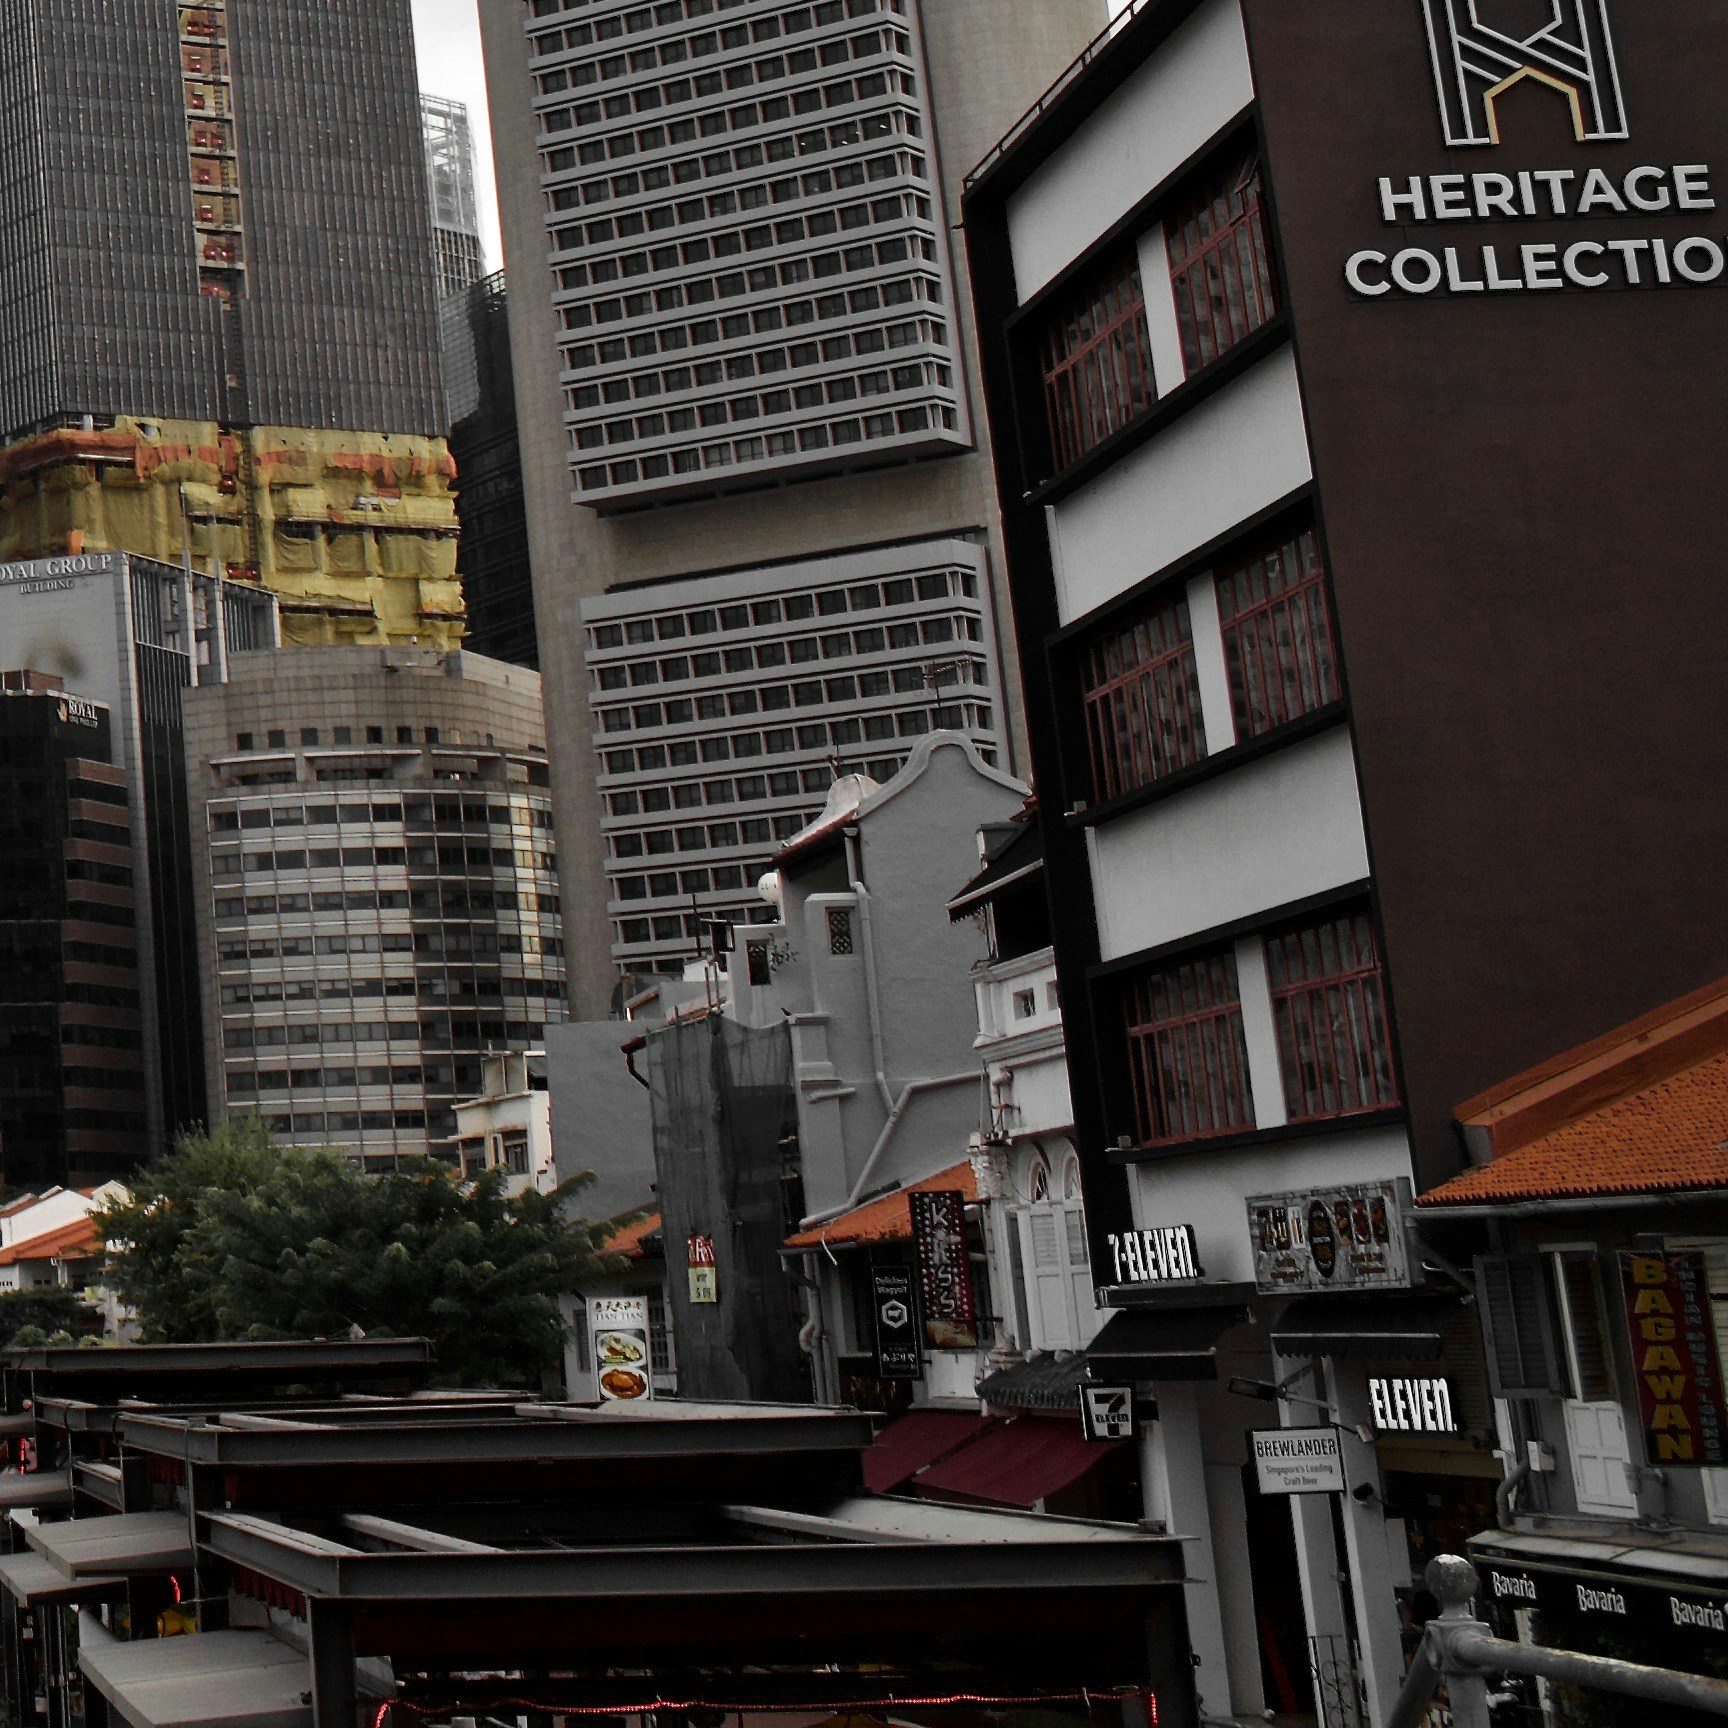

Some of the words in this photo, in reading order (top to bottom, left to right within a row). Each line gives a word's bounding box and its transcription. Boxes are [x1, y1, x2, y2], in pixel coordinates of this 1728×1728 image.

[1378, 164, 1715, 222] HERITAGE
[1345, 236, 1728, 296] COLLECTIO
[46, 553, 112, 576] GROUP
[21, 580, 75, 595] BUILDING
[68, 700, 98, 721] ROYAL
[1630, 1256, 1695, 1460] BAGAWAN
[1093, 1392, 1127, 1437] 7
[1256, 1438, 1337, 1458] BREWLANDER
[1491, 1571, 1538, 1600] Bavaria
[1576, 1584, 1627, 1614] Bavaria
[1670, 1596, 1725, 1631] Bavaria
